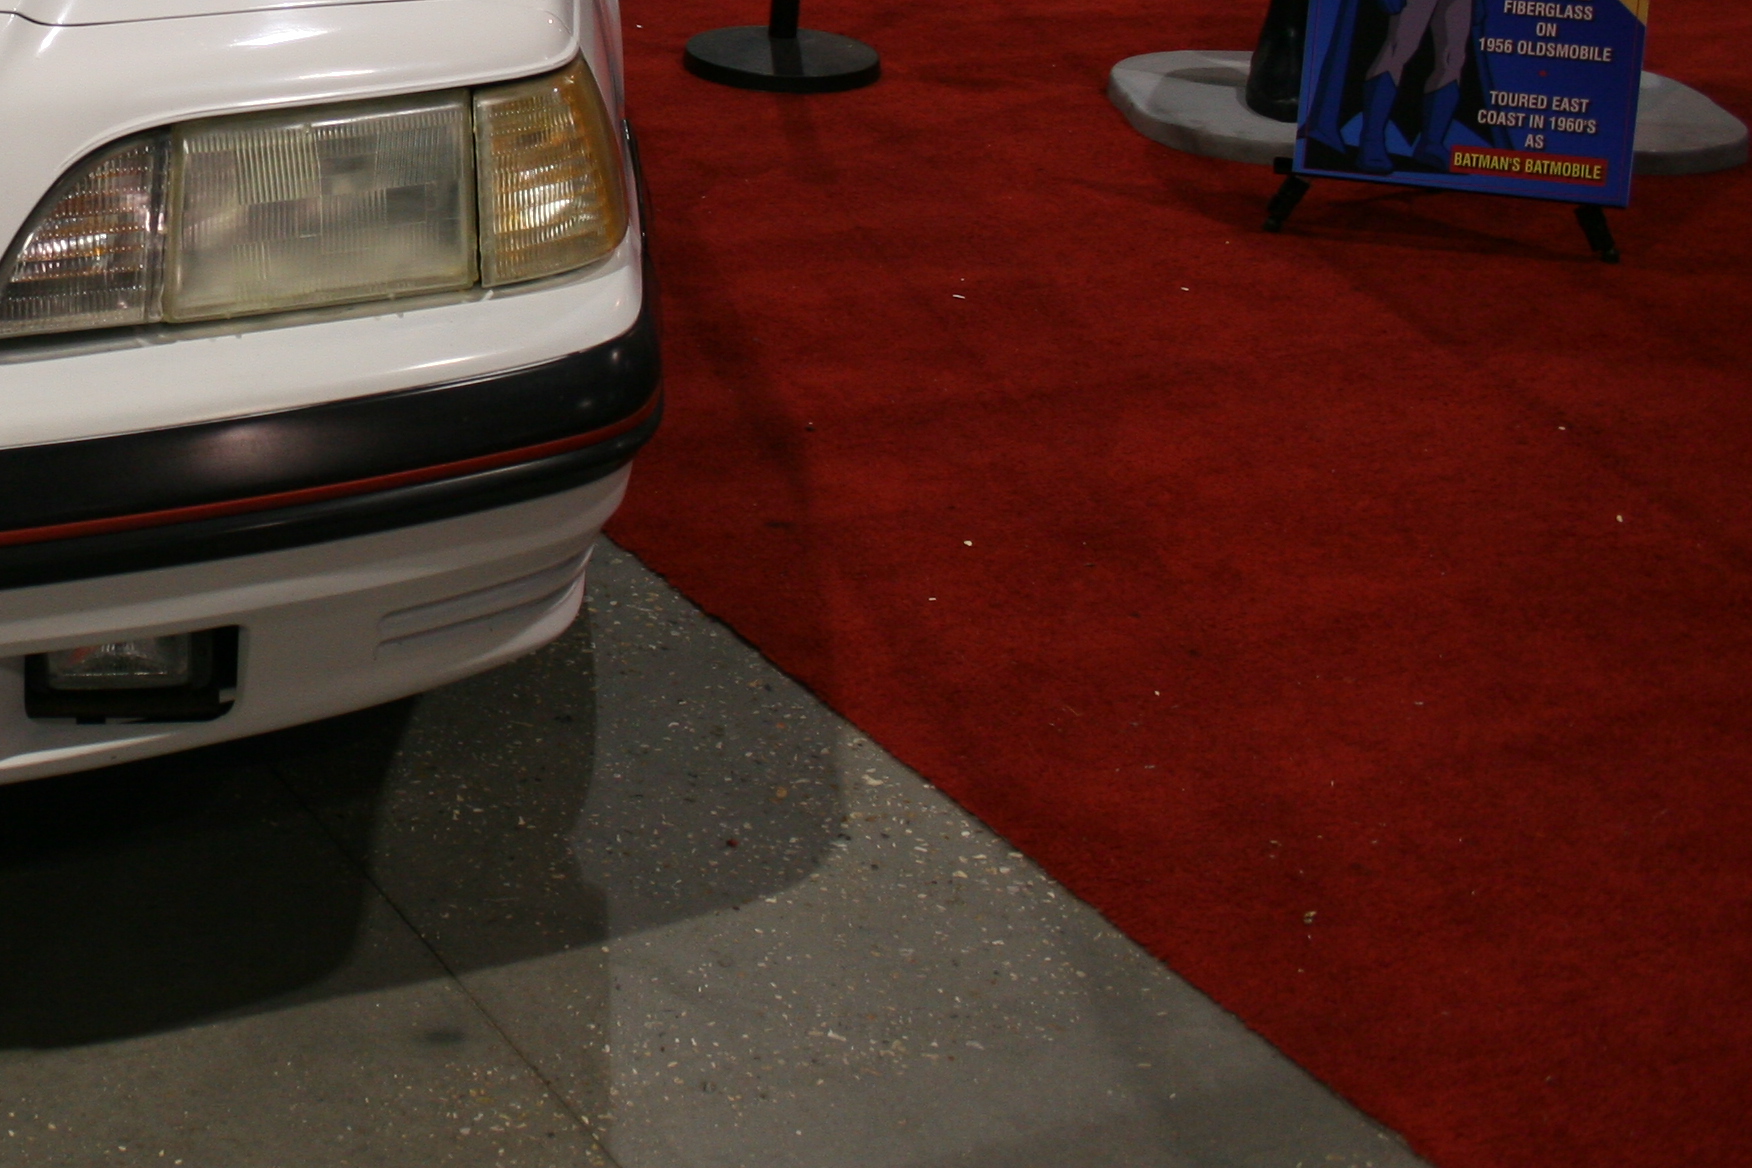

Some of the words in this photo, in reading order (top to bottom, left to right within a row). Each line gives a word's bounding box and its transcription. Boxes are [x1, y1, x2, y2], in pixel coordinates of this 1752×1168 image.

[1503, 0, 1593, 20] FIBERGLASS
[1536, 22, 1557, 37] ON
[1478, 37, 1513, 54] 1956
[1517, 40, 1612, 62] OLDSMOBILE
[1490, 90, 1548, 110] TOURED
[1552, 96, 1589, 113] EAST
[1477, 109, 1526, 127] COAST
[1529, 114, 1544, 129] IN
[1549, 116, 1597, 134] 1960'S
[1524, 134, 1544, 149] AS
[1453, 152, 1521, 172] BATMAN'S
[1525, 158, 1602, 180] BATMOBILE
